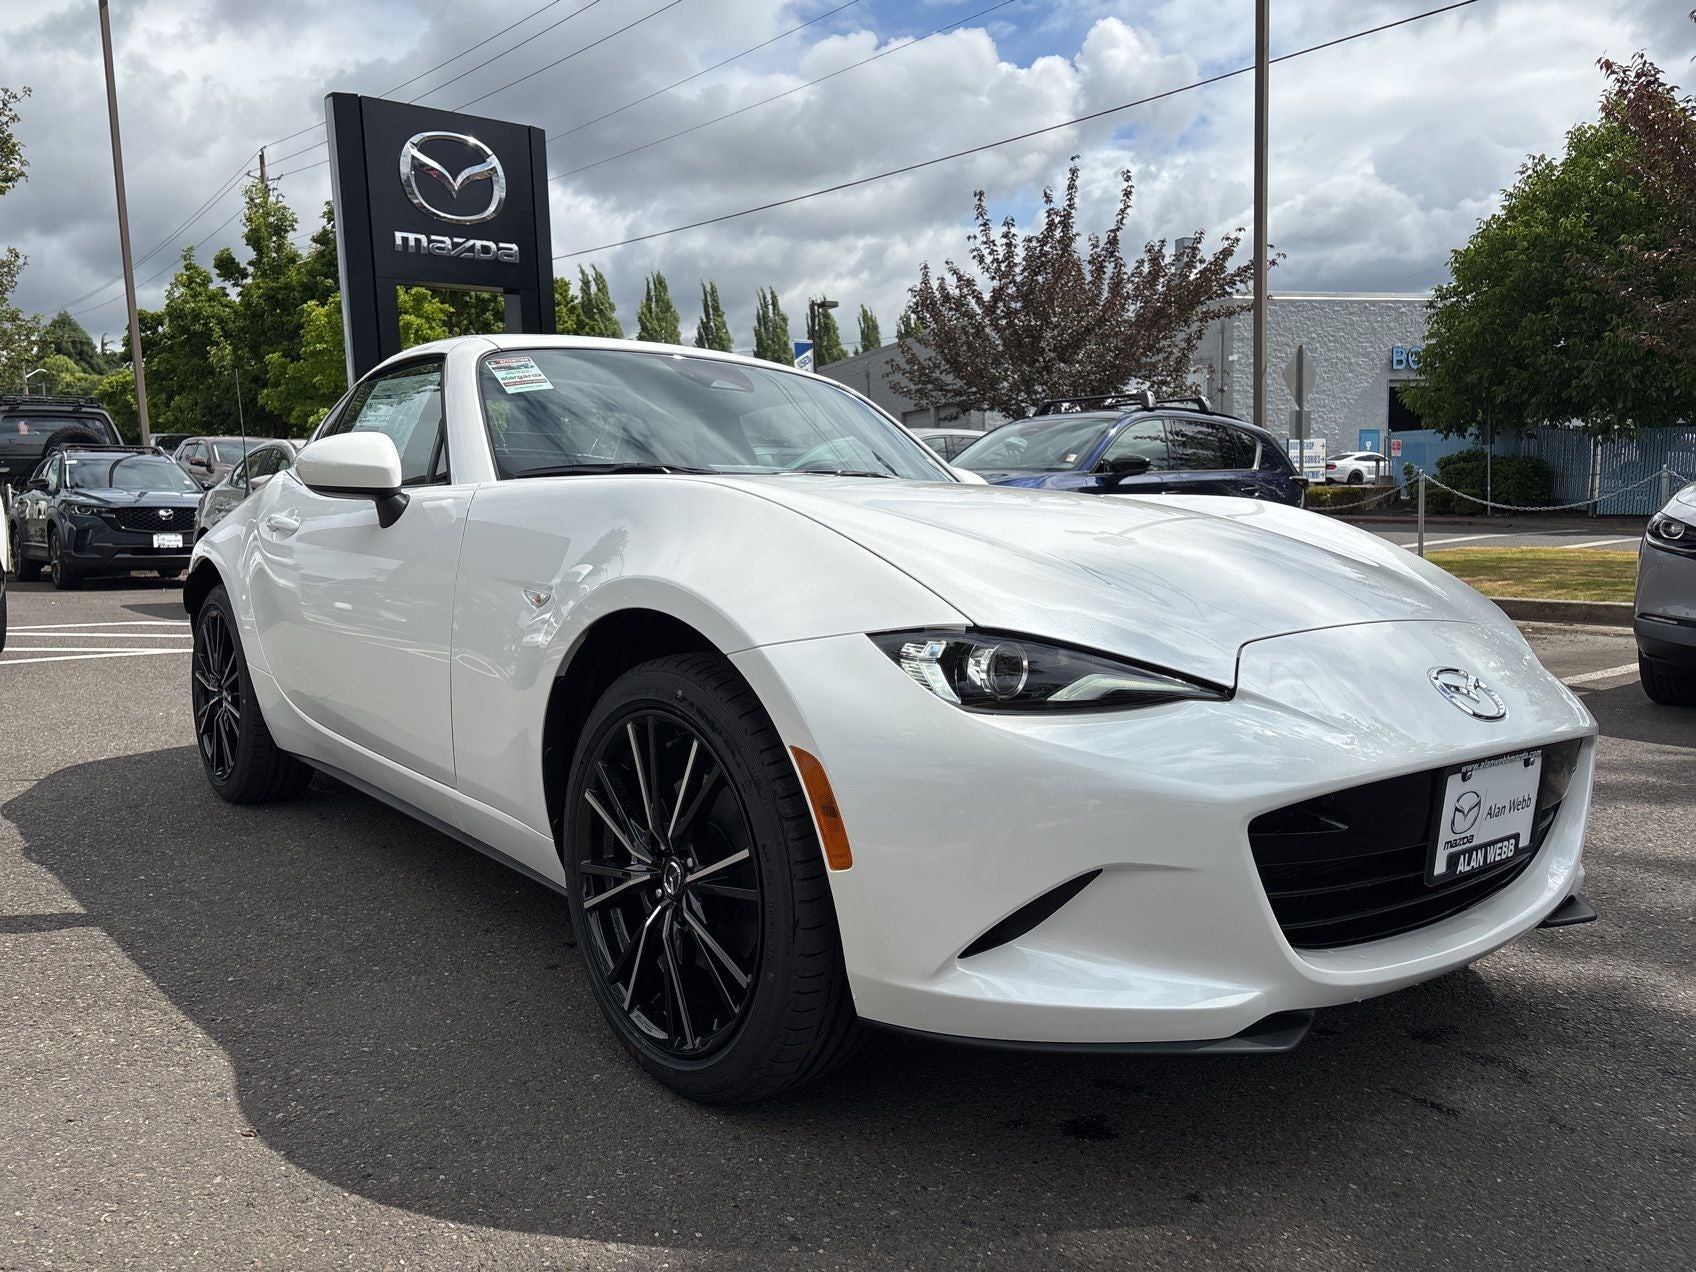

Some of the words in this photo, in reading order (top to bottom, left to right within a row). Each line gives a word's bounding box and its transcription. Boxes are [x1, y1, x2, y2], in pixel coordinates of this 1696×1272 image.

[394, 231, 520, 263] mazda
[1289, 441, 1299, 450] BOD
[1303, 441, 1315, 450] SHOP
[1289, 455, 1321, 464] ACCSORIES
[1484, 804, 1507, 820] Alan
[1508, 793, 1532, 814] Webb
[1443, 834, 1475, 851] mazda
[1456, 847, 1486, 874] ALAN
[1487, 839, 1516, 864] WEBB
